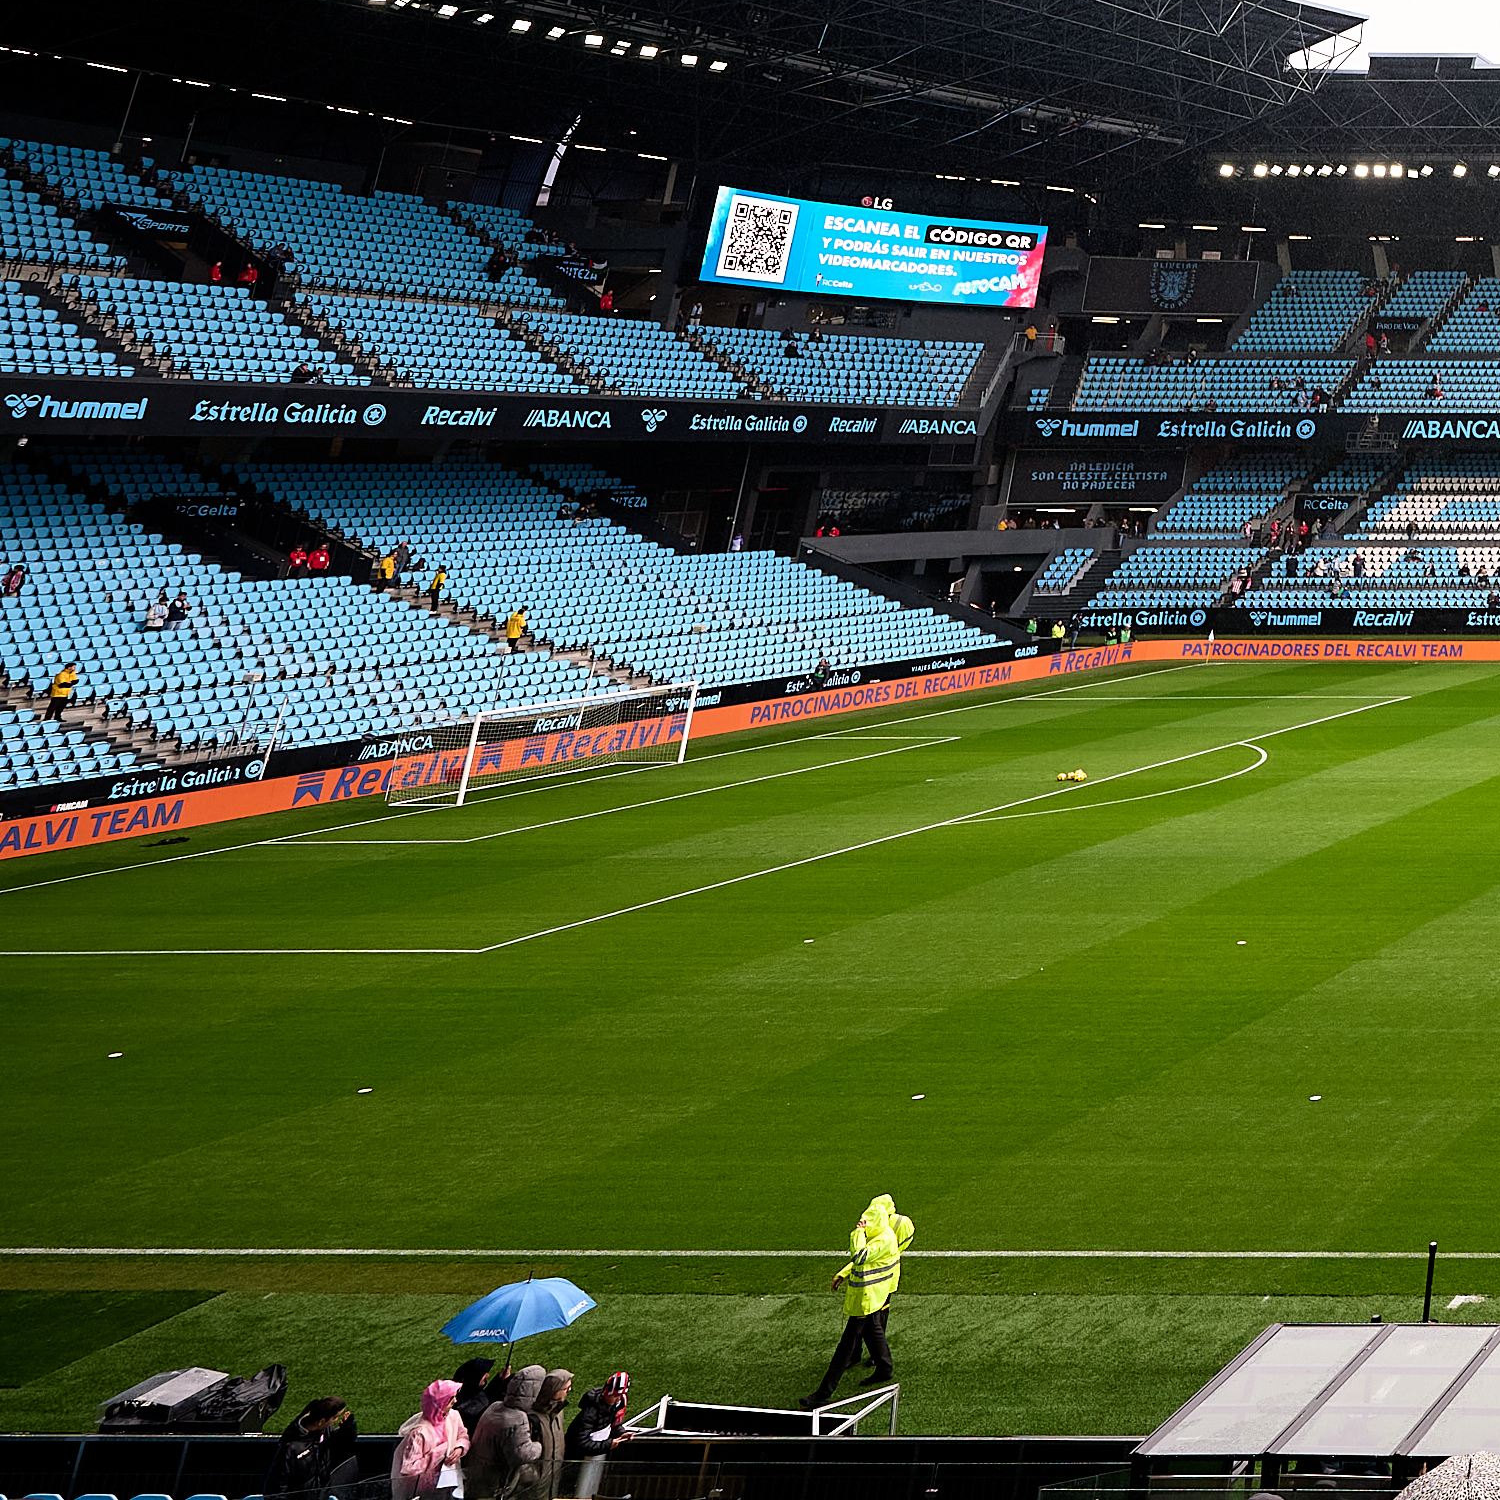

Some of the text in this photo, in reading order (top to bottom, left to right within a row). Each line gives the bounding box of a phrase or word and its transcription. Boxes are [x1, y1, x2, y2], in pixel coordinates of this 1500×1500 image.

[873, 198, 893, 210] LG
[823, 216, 1032, 249] ESCANEA EL CÓDIGO QR
[822, 237, 1028, 266] Y PODRÁS SALIR EN NUESTROS
[818, 253, 958, 277] VIDEOMARCADORES.
[39, 395, 148, 420] hummel
[190, 400, 356, 426] Estrella Galicia
[421, 406, 498, 427] Recalvi
[689, 413, 790, 433] Estrella Galicia
[829, 416, 878, 434] Recalvi
[1061, 420, 1139, 437] hummel
[1157, 420, 1292, 438] Estrella Galicia
[1031, 472, 1055, 481] SON
[1114, 472, 1168, 481] CELTISTA
[1082, 481, 1136, 490] PADECER
[1303, 499, 1349, 510] RCCelta
[1135, 611, 1188, 627] Galicia
[1266, 611, 1321, 626] hummel
[1353, 610, 1414, 627] Recalvi
[1014, 645, 1039, 658] GADIS
[1063, 645, 1121, 673] Recalvi
[1182, 642, 1463, 658] PATROCINADORES DEL RECALVI TEAM
[750, 665, 1012, 724] PATROCINADORES DEL RECALVI TEAM
[533, 713, 581, 734] Recalvi
[551, 716, 665, 763] Recalvi
[330, 750, 470, 801] Recalvi
[107, 776, 176, 800] Estrela
[91, 799, 185, 838] TEAM
